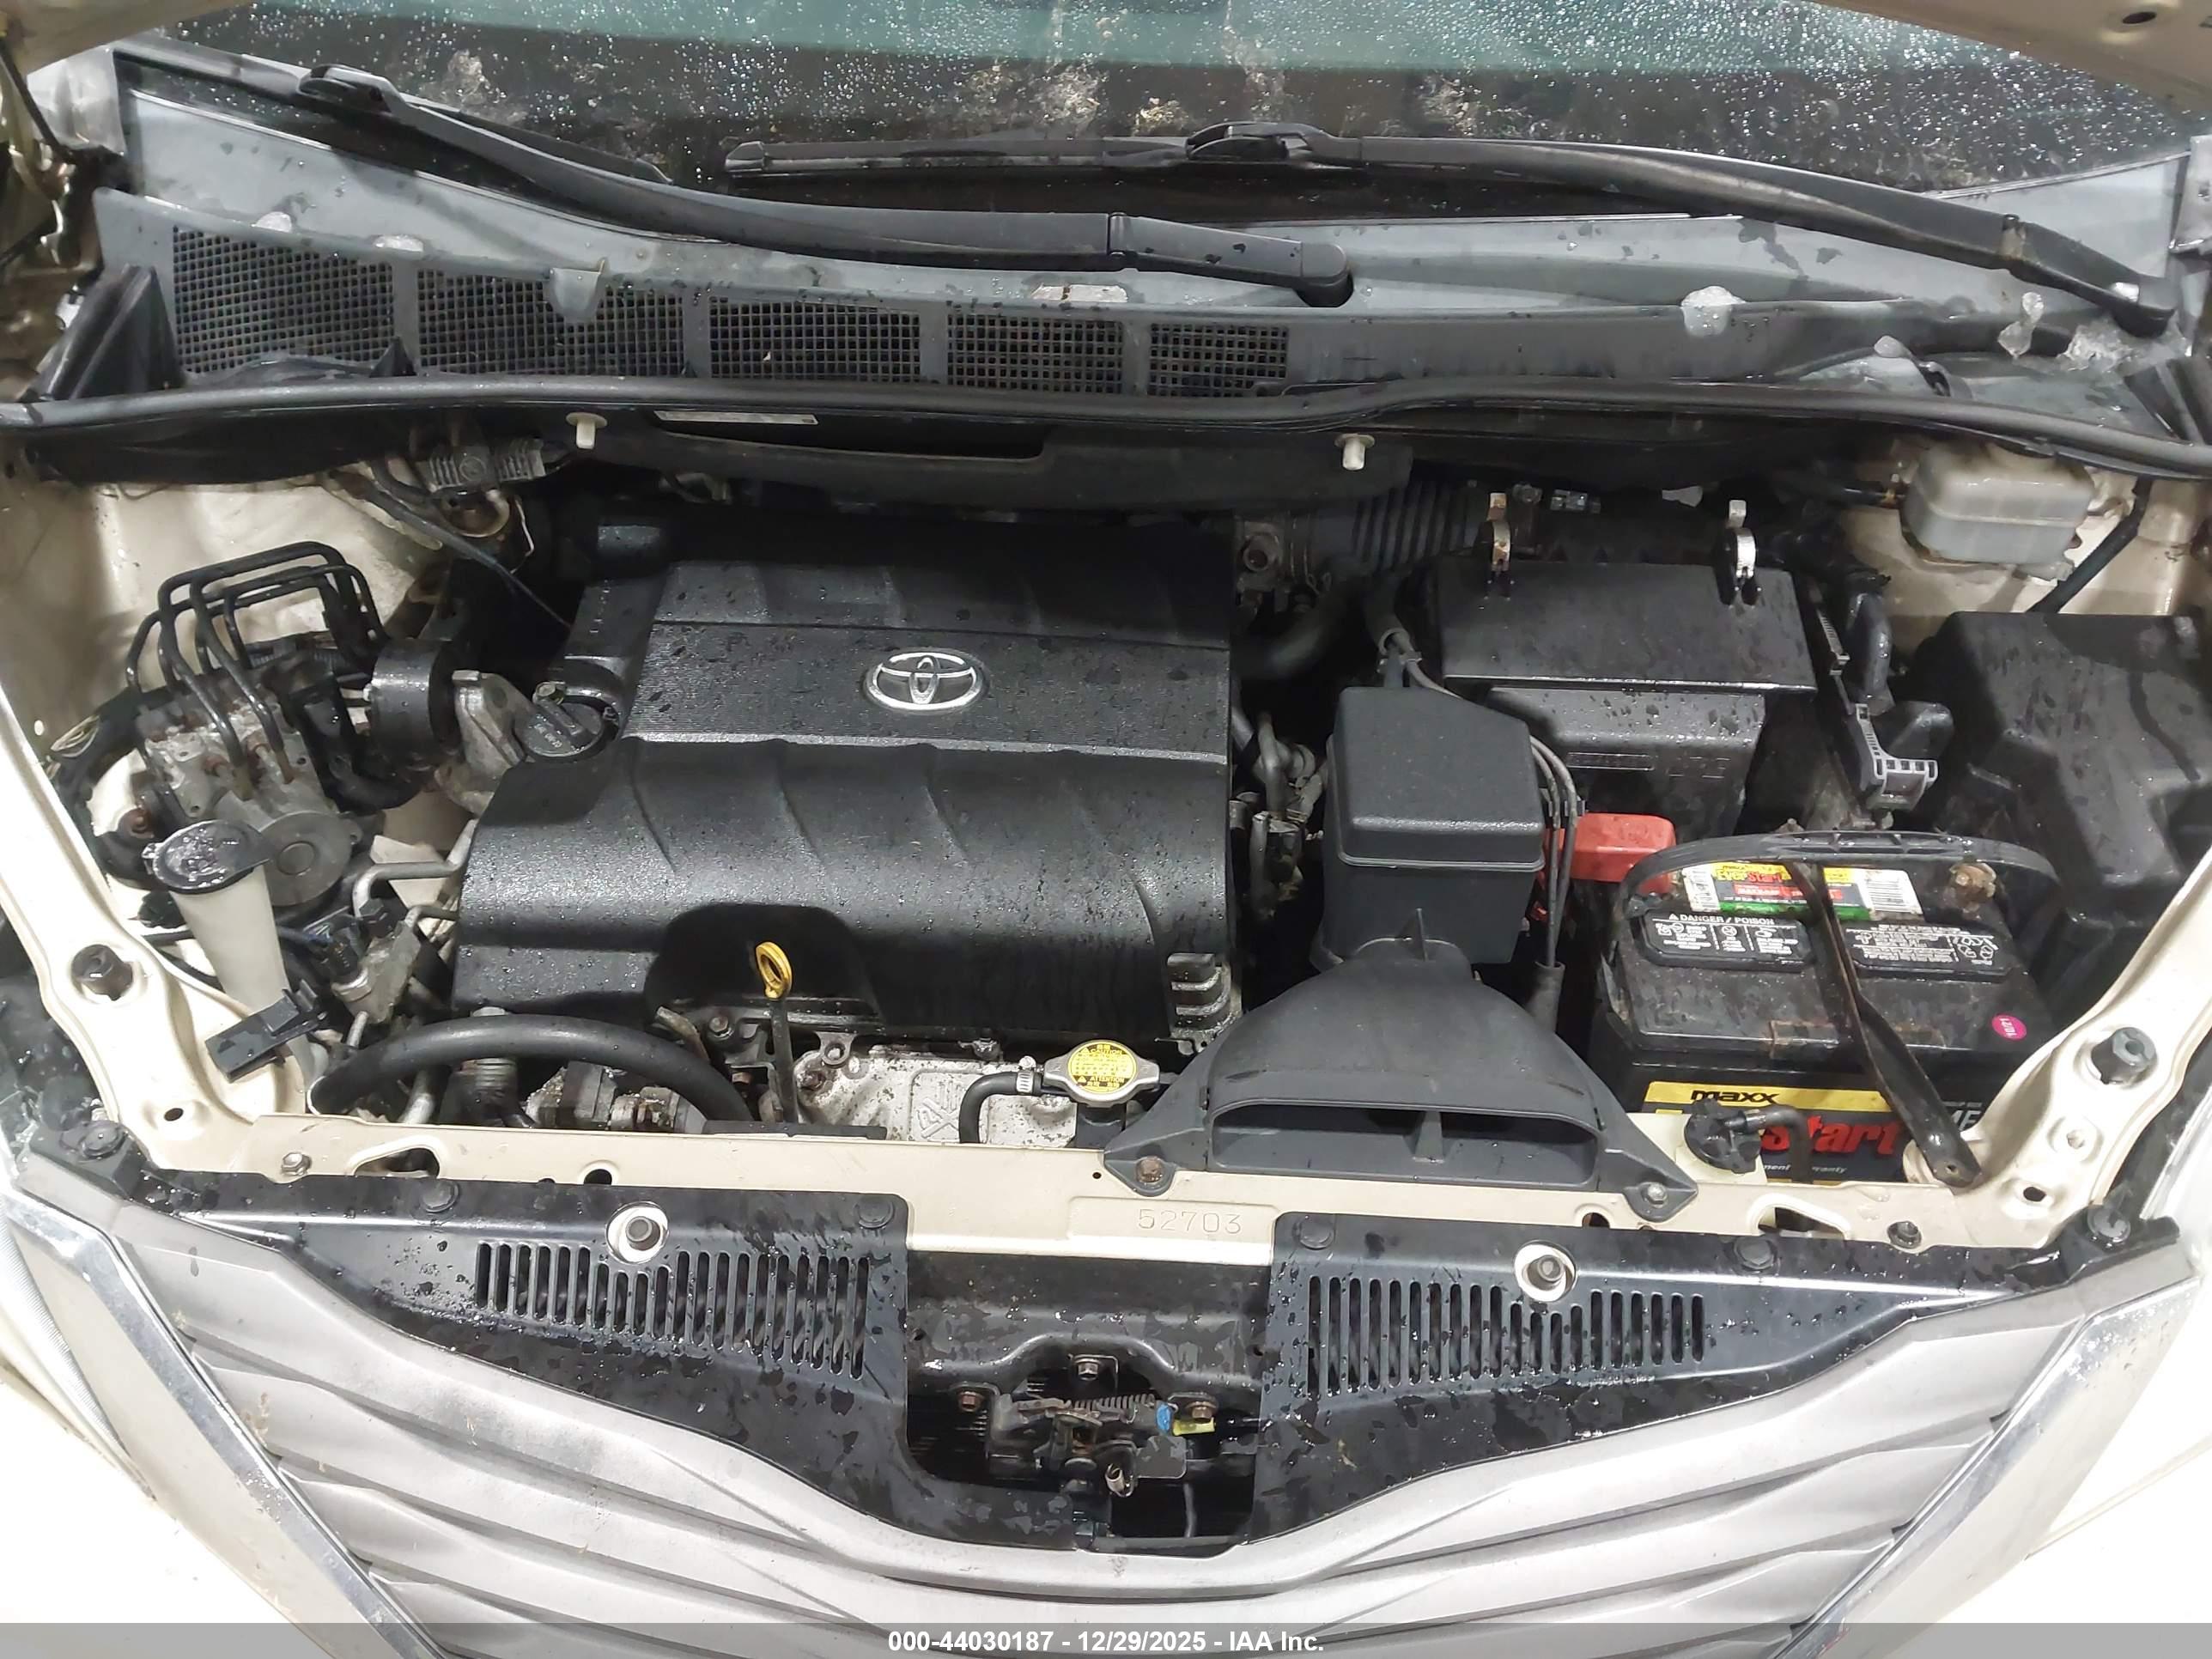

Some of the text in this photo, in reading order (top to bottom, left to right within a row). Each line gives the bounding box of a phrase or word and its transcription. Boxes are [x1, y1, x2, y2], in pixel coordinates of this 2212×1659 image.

[1680, 914, 1724, 924] DANGER
[1735, 917, 1775, 926] POISON
[1138, 1208, 1242, 1235] 52703
